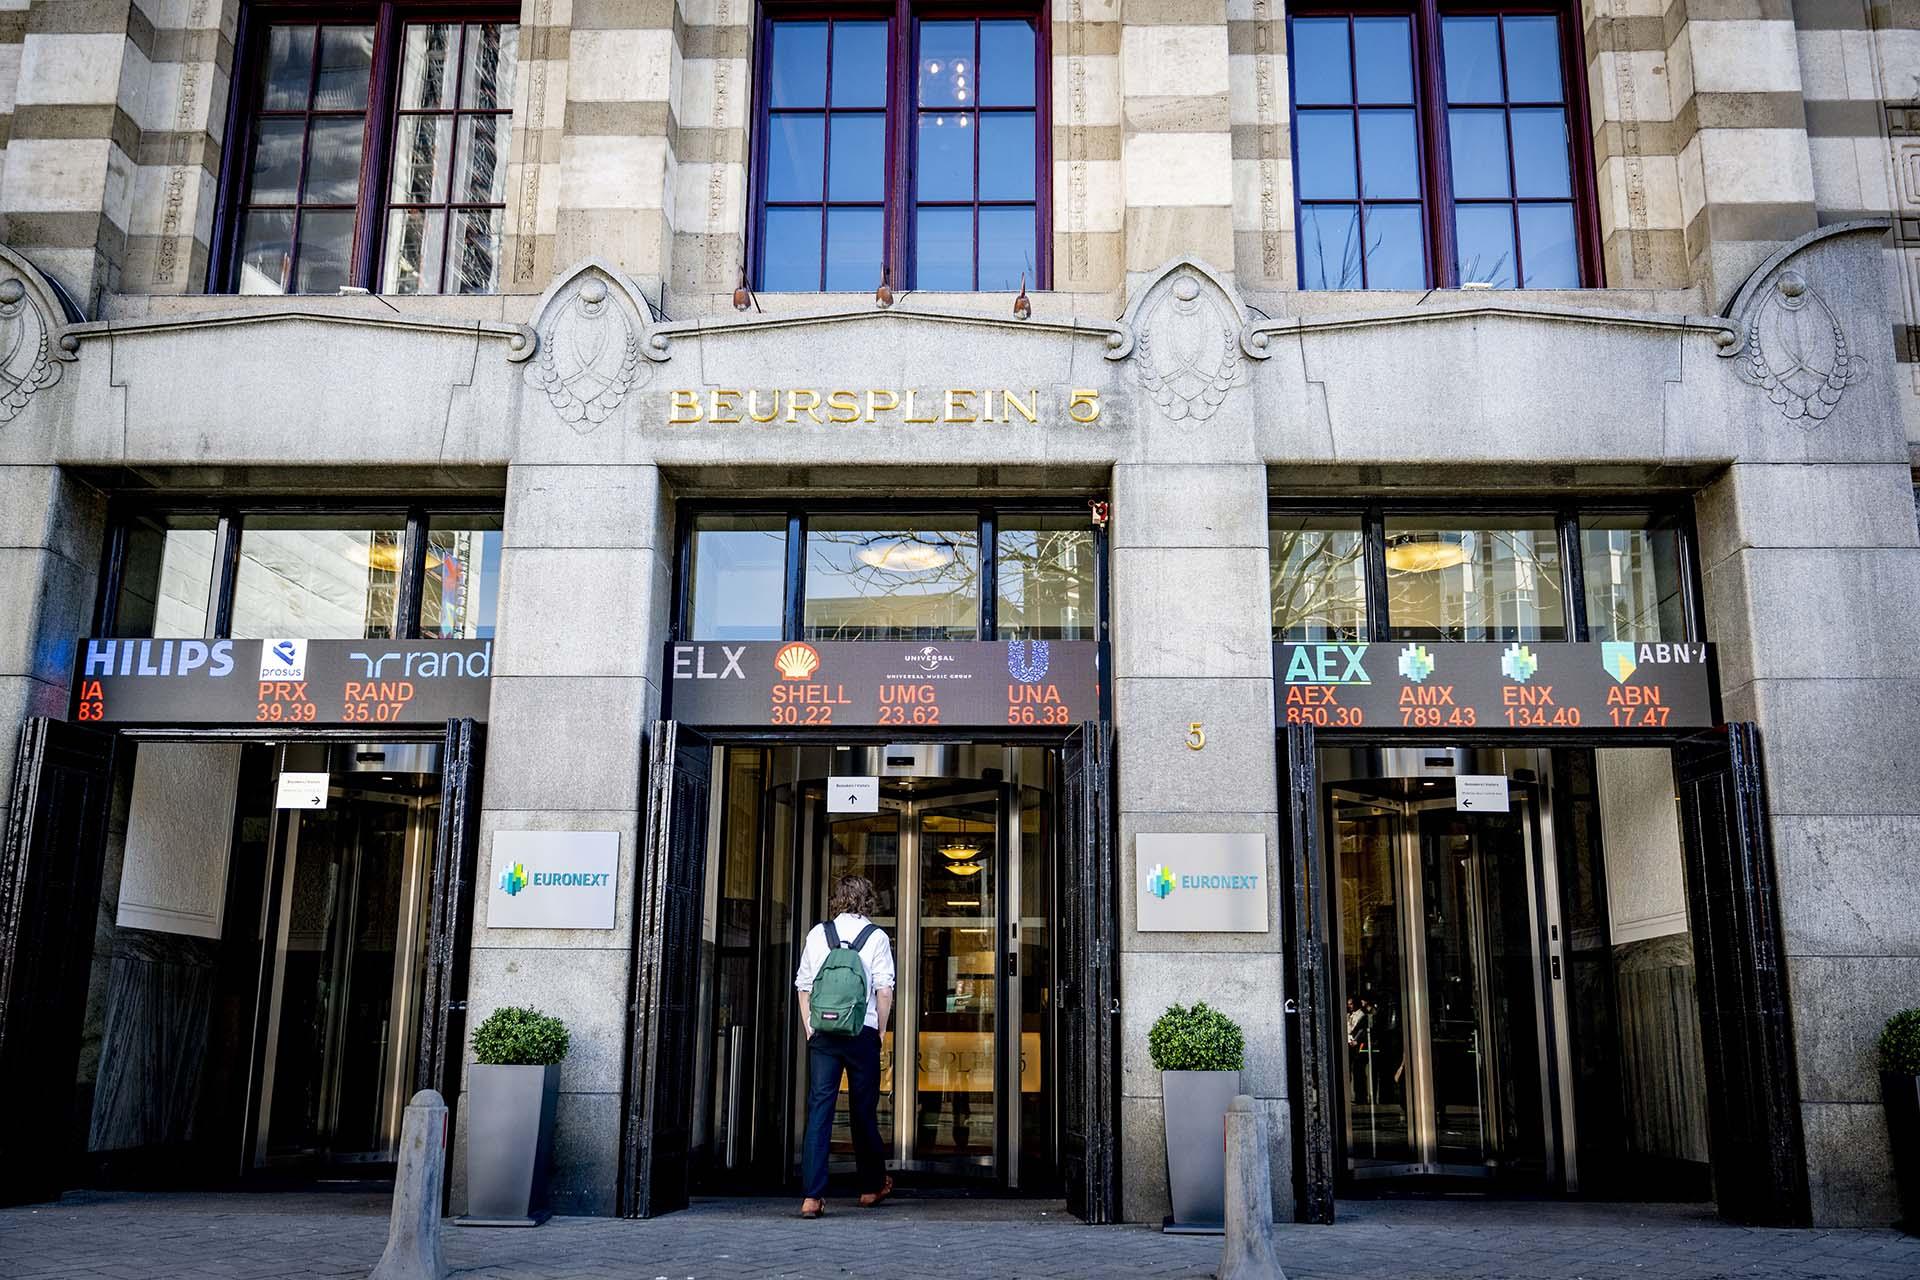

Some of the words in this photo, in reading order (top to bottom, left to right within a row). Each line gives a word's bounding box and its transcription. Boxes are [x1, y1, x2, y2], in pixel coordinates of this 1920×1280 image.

[669, 389, 1038, 424] BEURSPLEIN
[1069, 389, 1099, 423] 5
[84, 640, 234, 676] HILIPS
[404, 641, 491, 678] rand
[673, 646, 747, 679] ELX
[1285, 645, 1370, 682] AEX
[262, 668, 302, 678] prosus
[258, 681, 308, 701] PRX
[344, 682, 414, 701] RAND
[771, 684, 852, 704] SHELL
[879, 684, 936, 704] UMG
[1008, 684, 1061, 704] UNA
[1286, 686, 1338, 705] AEX
[1399, 686, 1454, 705] AMX
[1503, 686, 1554, 705] ENX
[1606, 686, 1661, 705] ABN
[256, 702, 317, 721] 39.39
[342, 702, 403, 722] 35.07
[771, 705, 833, 725] 30.22
[878, 705, 940, 725] 23.62
[1007, 705, 1070, 725] 56.38
[1287, 707, 1364, 727] 850.30
[1400, 706, 1477, 727] 789.43
[1503, 706, 1581, 727] 134.40
[1609, 706, 1671, 727] 17.47
[1185, 722, 1206, 750] 5
[533, 872, 609, 887] EURONEXT
[1181, 875, 1259, 890] EURONEXT
